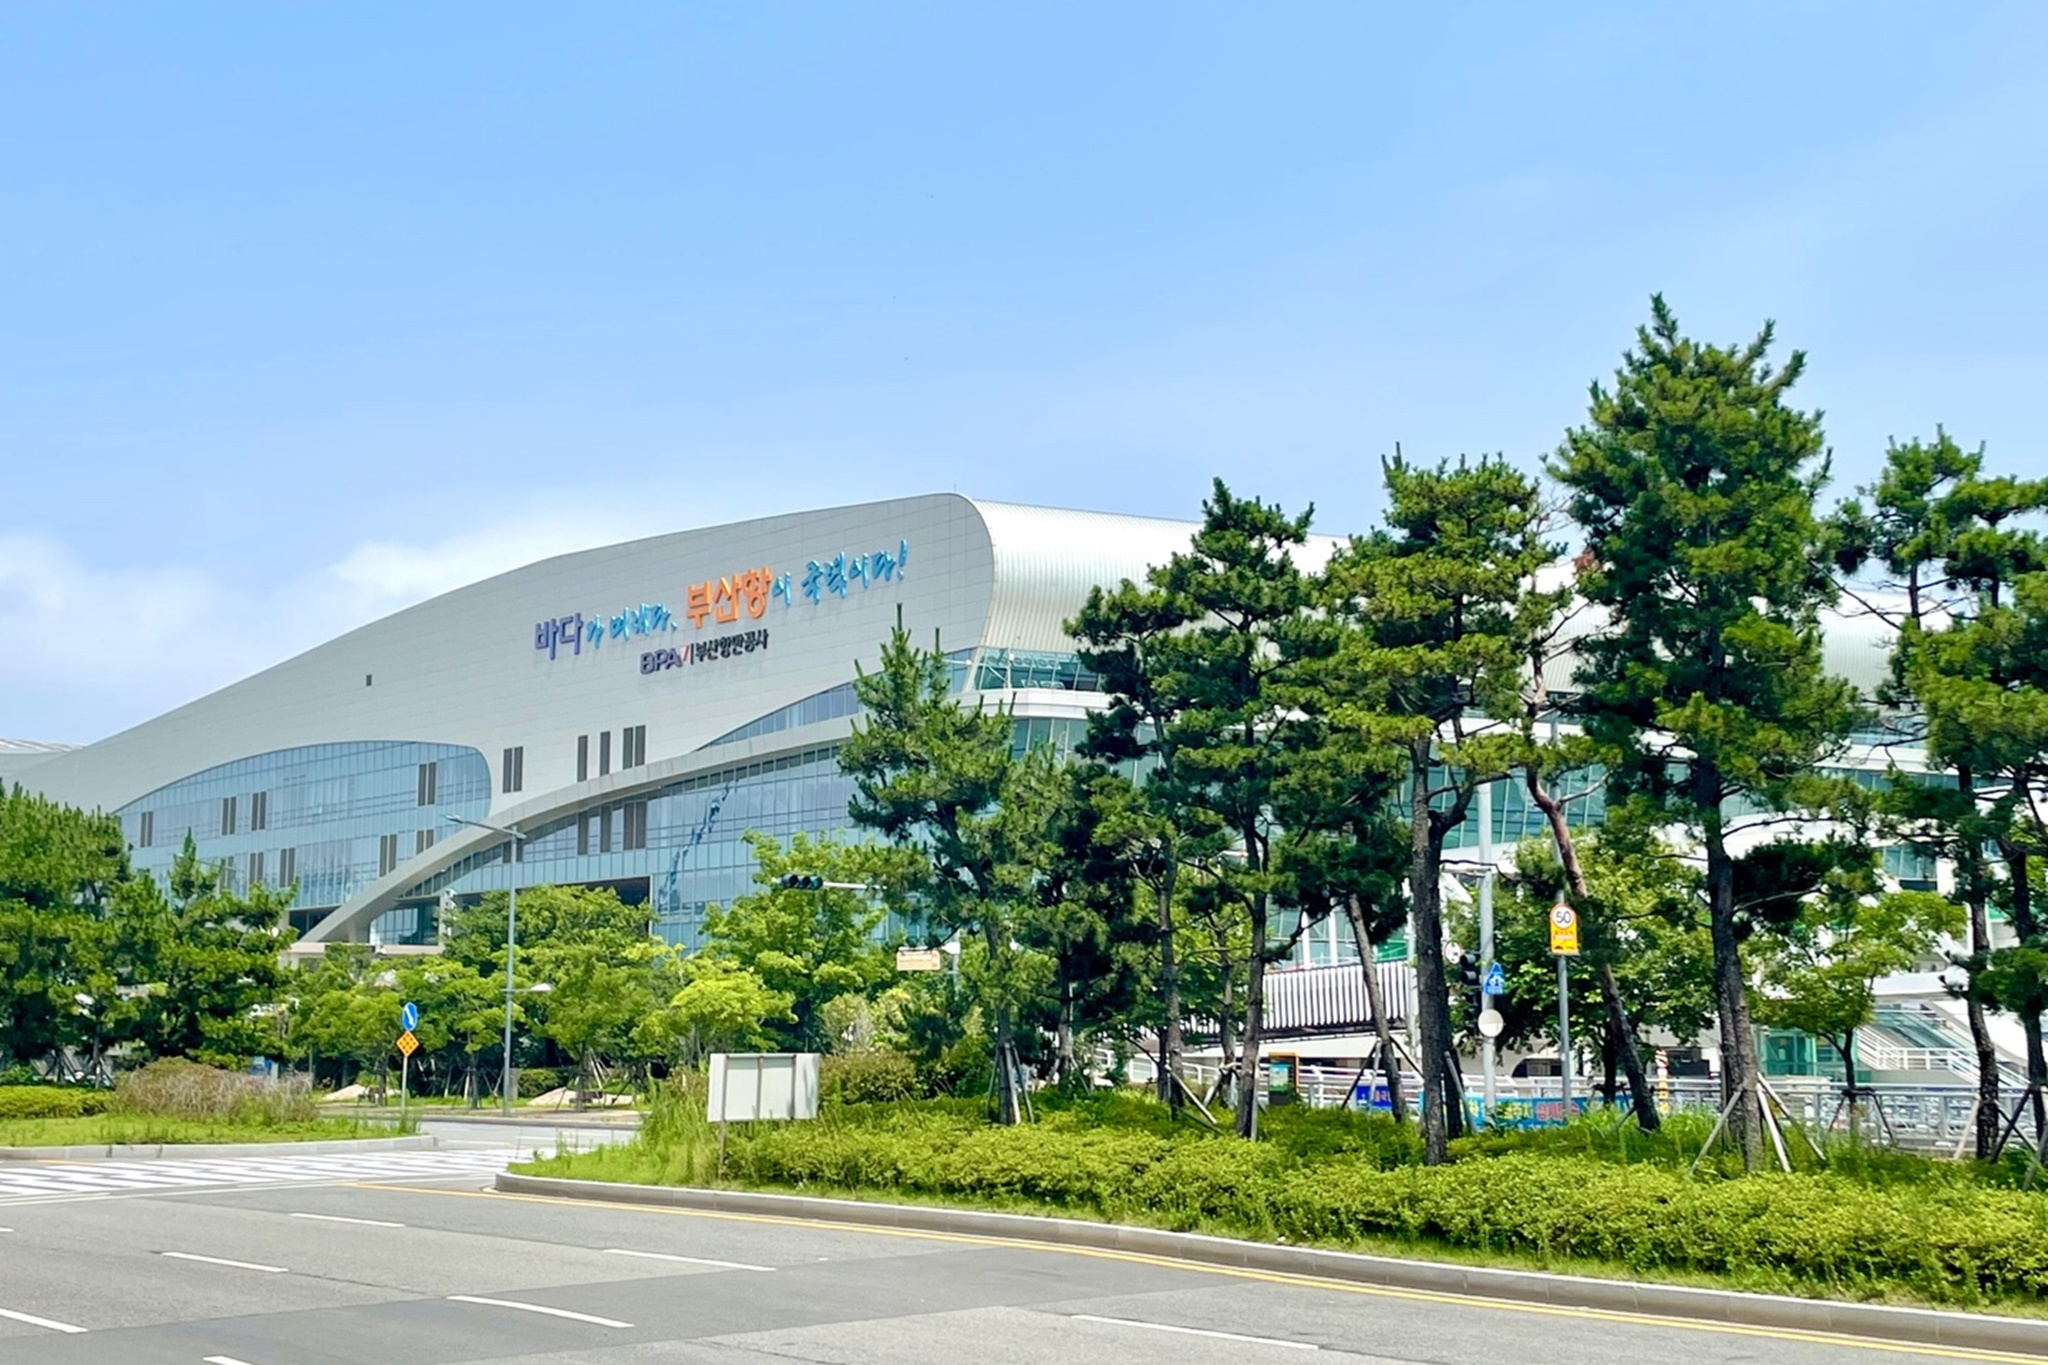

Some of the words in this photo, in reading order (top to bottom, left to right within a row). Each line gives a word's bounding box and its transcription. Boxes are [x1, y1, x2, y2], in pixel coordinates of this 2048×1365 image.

[535, 612, 605, 661] 바다가
[686, 566, 792, 630] 부산항이
[801, 538, 909, 606] 국력이다!
[695, 628, 770, 662] 부산항만공사
[640, 648, 684, 674] BPA
[1555, 910, 1572, 924] 50
